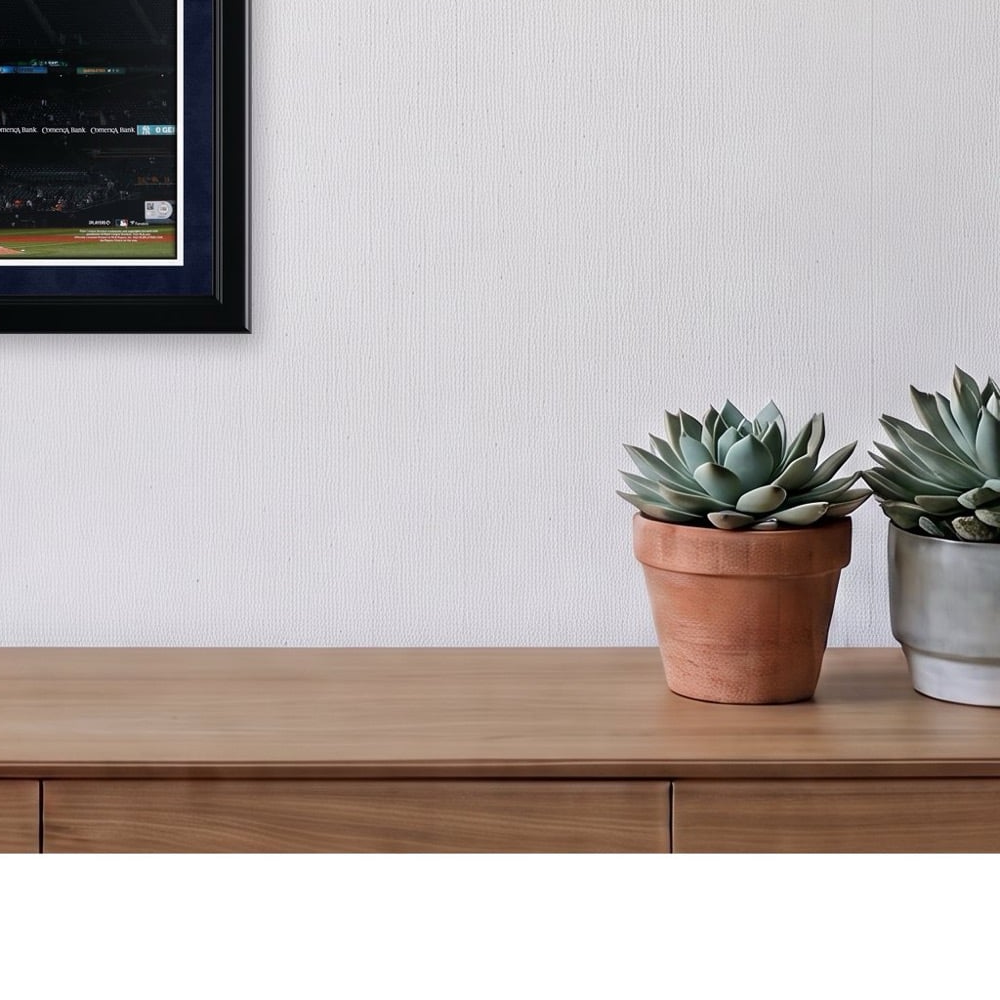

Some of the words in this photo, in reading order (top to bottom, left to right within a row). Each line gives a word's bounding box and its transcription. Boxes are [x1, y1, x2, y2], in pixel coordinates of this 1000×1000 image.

[21, 126, 37, 134] Bank
[71, 126, 87, 134] Bank
[120, 126, 136, 134] Bank
